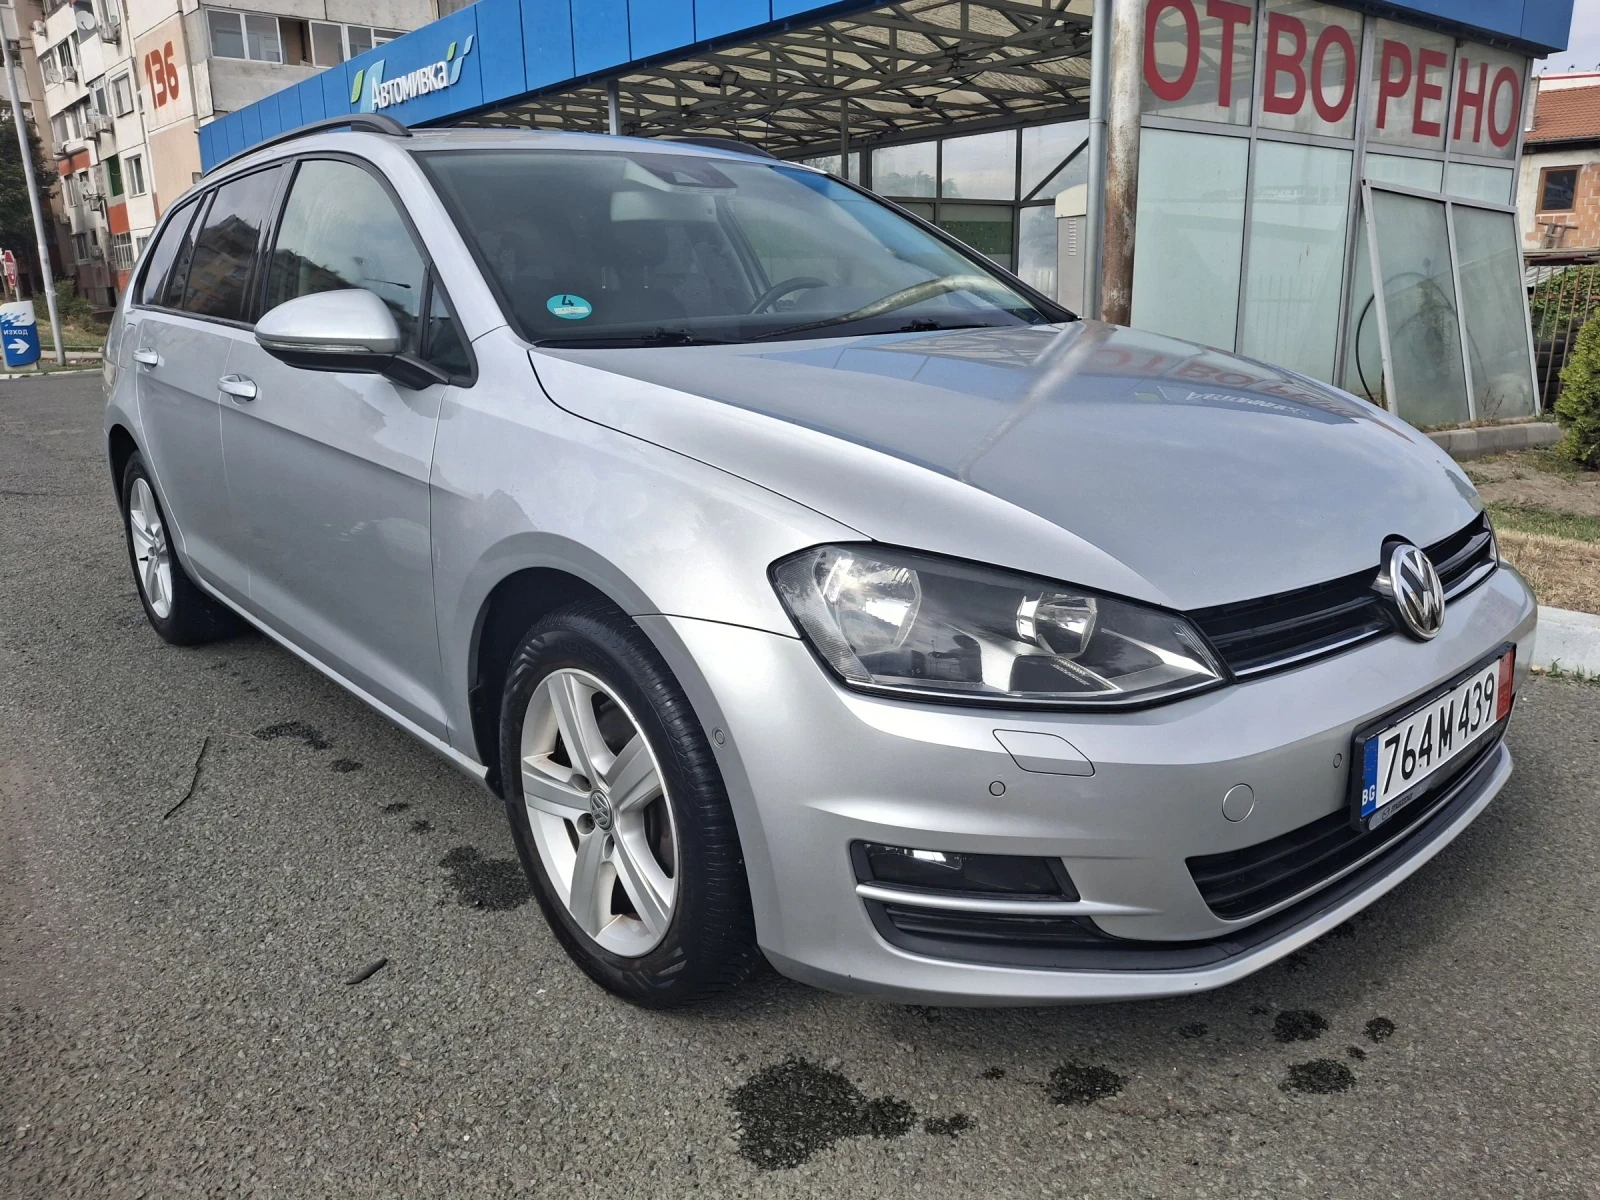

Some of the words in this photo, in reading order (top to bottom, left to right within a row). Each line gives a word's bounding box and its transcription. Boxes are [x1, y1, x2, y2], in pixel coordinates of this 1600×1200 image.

[145, 41, 179, 109] 136
[371, 60, 450, 112] Автомивка
[562, 295, 574, 306] 4
[1361, 784, 1375, 807] BG
